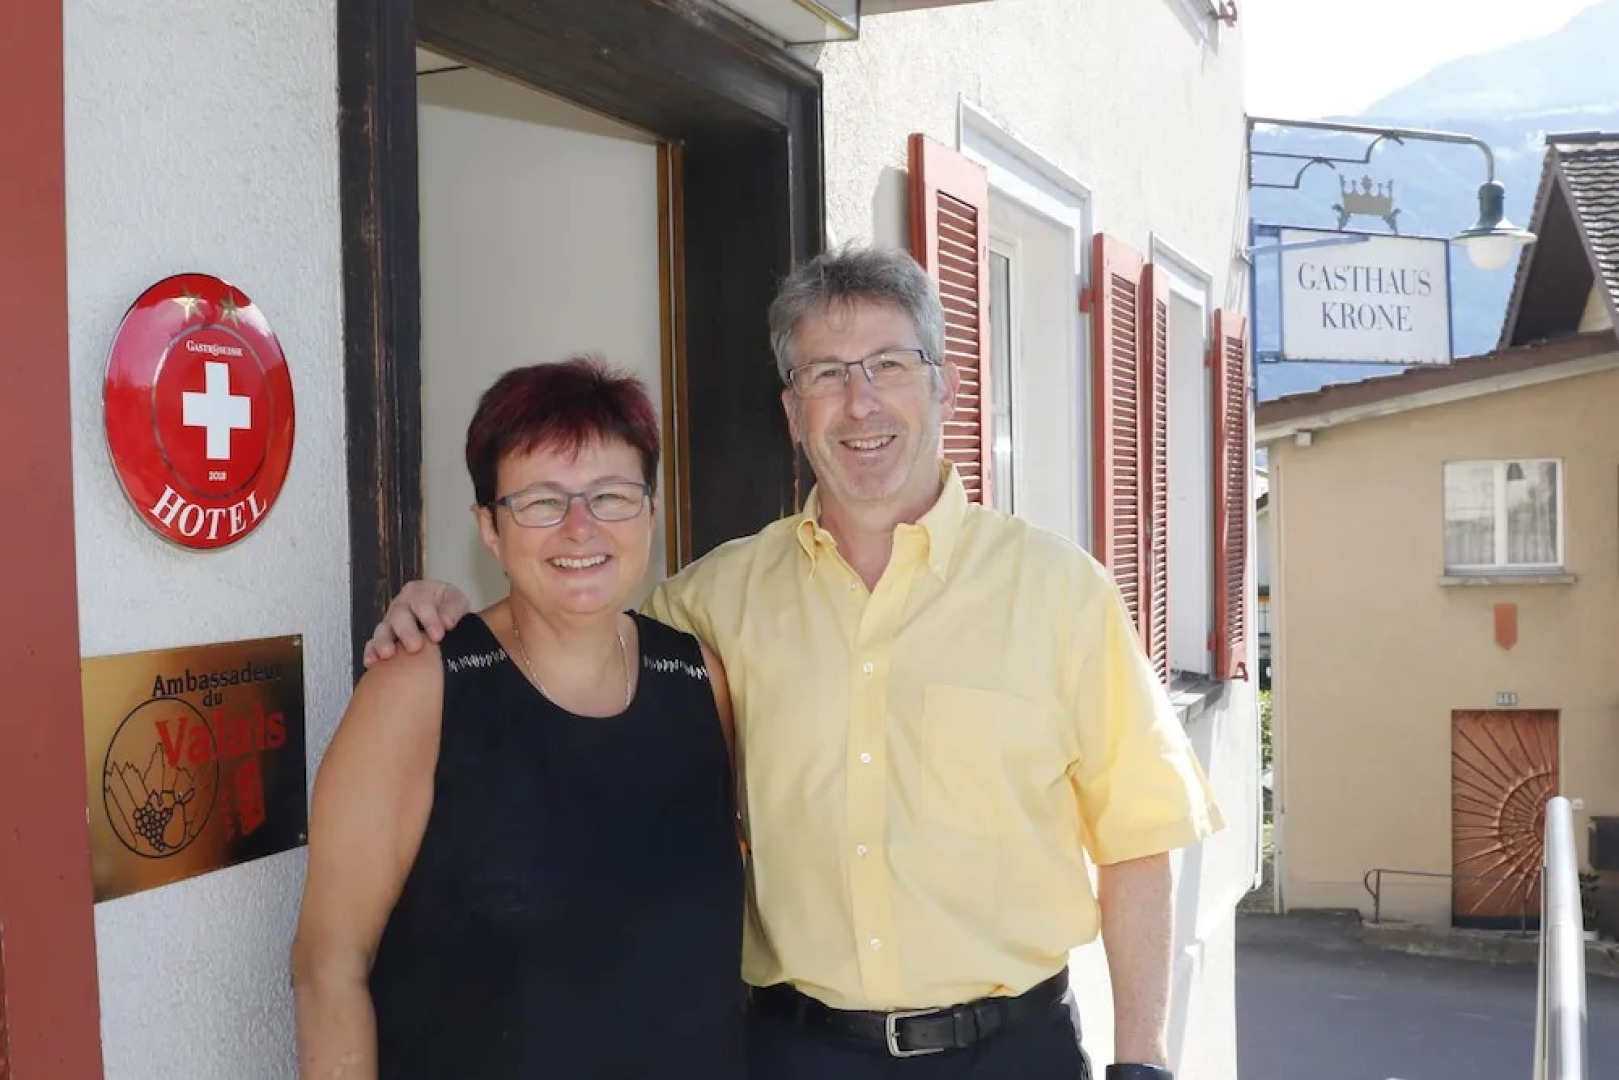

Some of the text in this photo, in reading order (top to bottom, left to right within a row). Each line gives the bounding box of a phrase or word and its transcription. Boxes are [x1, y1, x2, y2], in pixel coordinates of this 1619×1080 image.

[1298, 262, 1432, 295] GASTHAUS
[1322, 302, 1412, 331] KRONE
[151, 485, 266, 539] HOTEL
[203, 691, 223, 707] du
[155, 703, 286, 769] Valais
